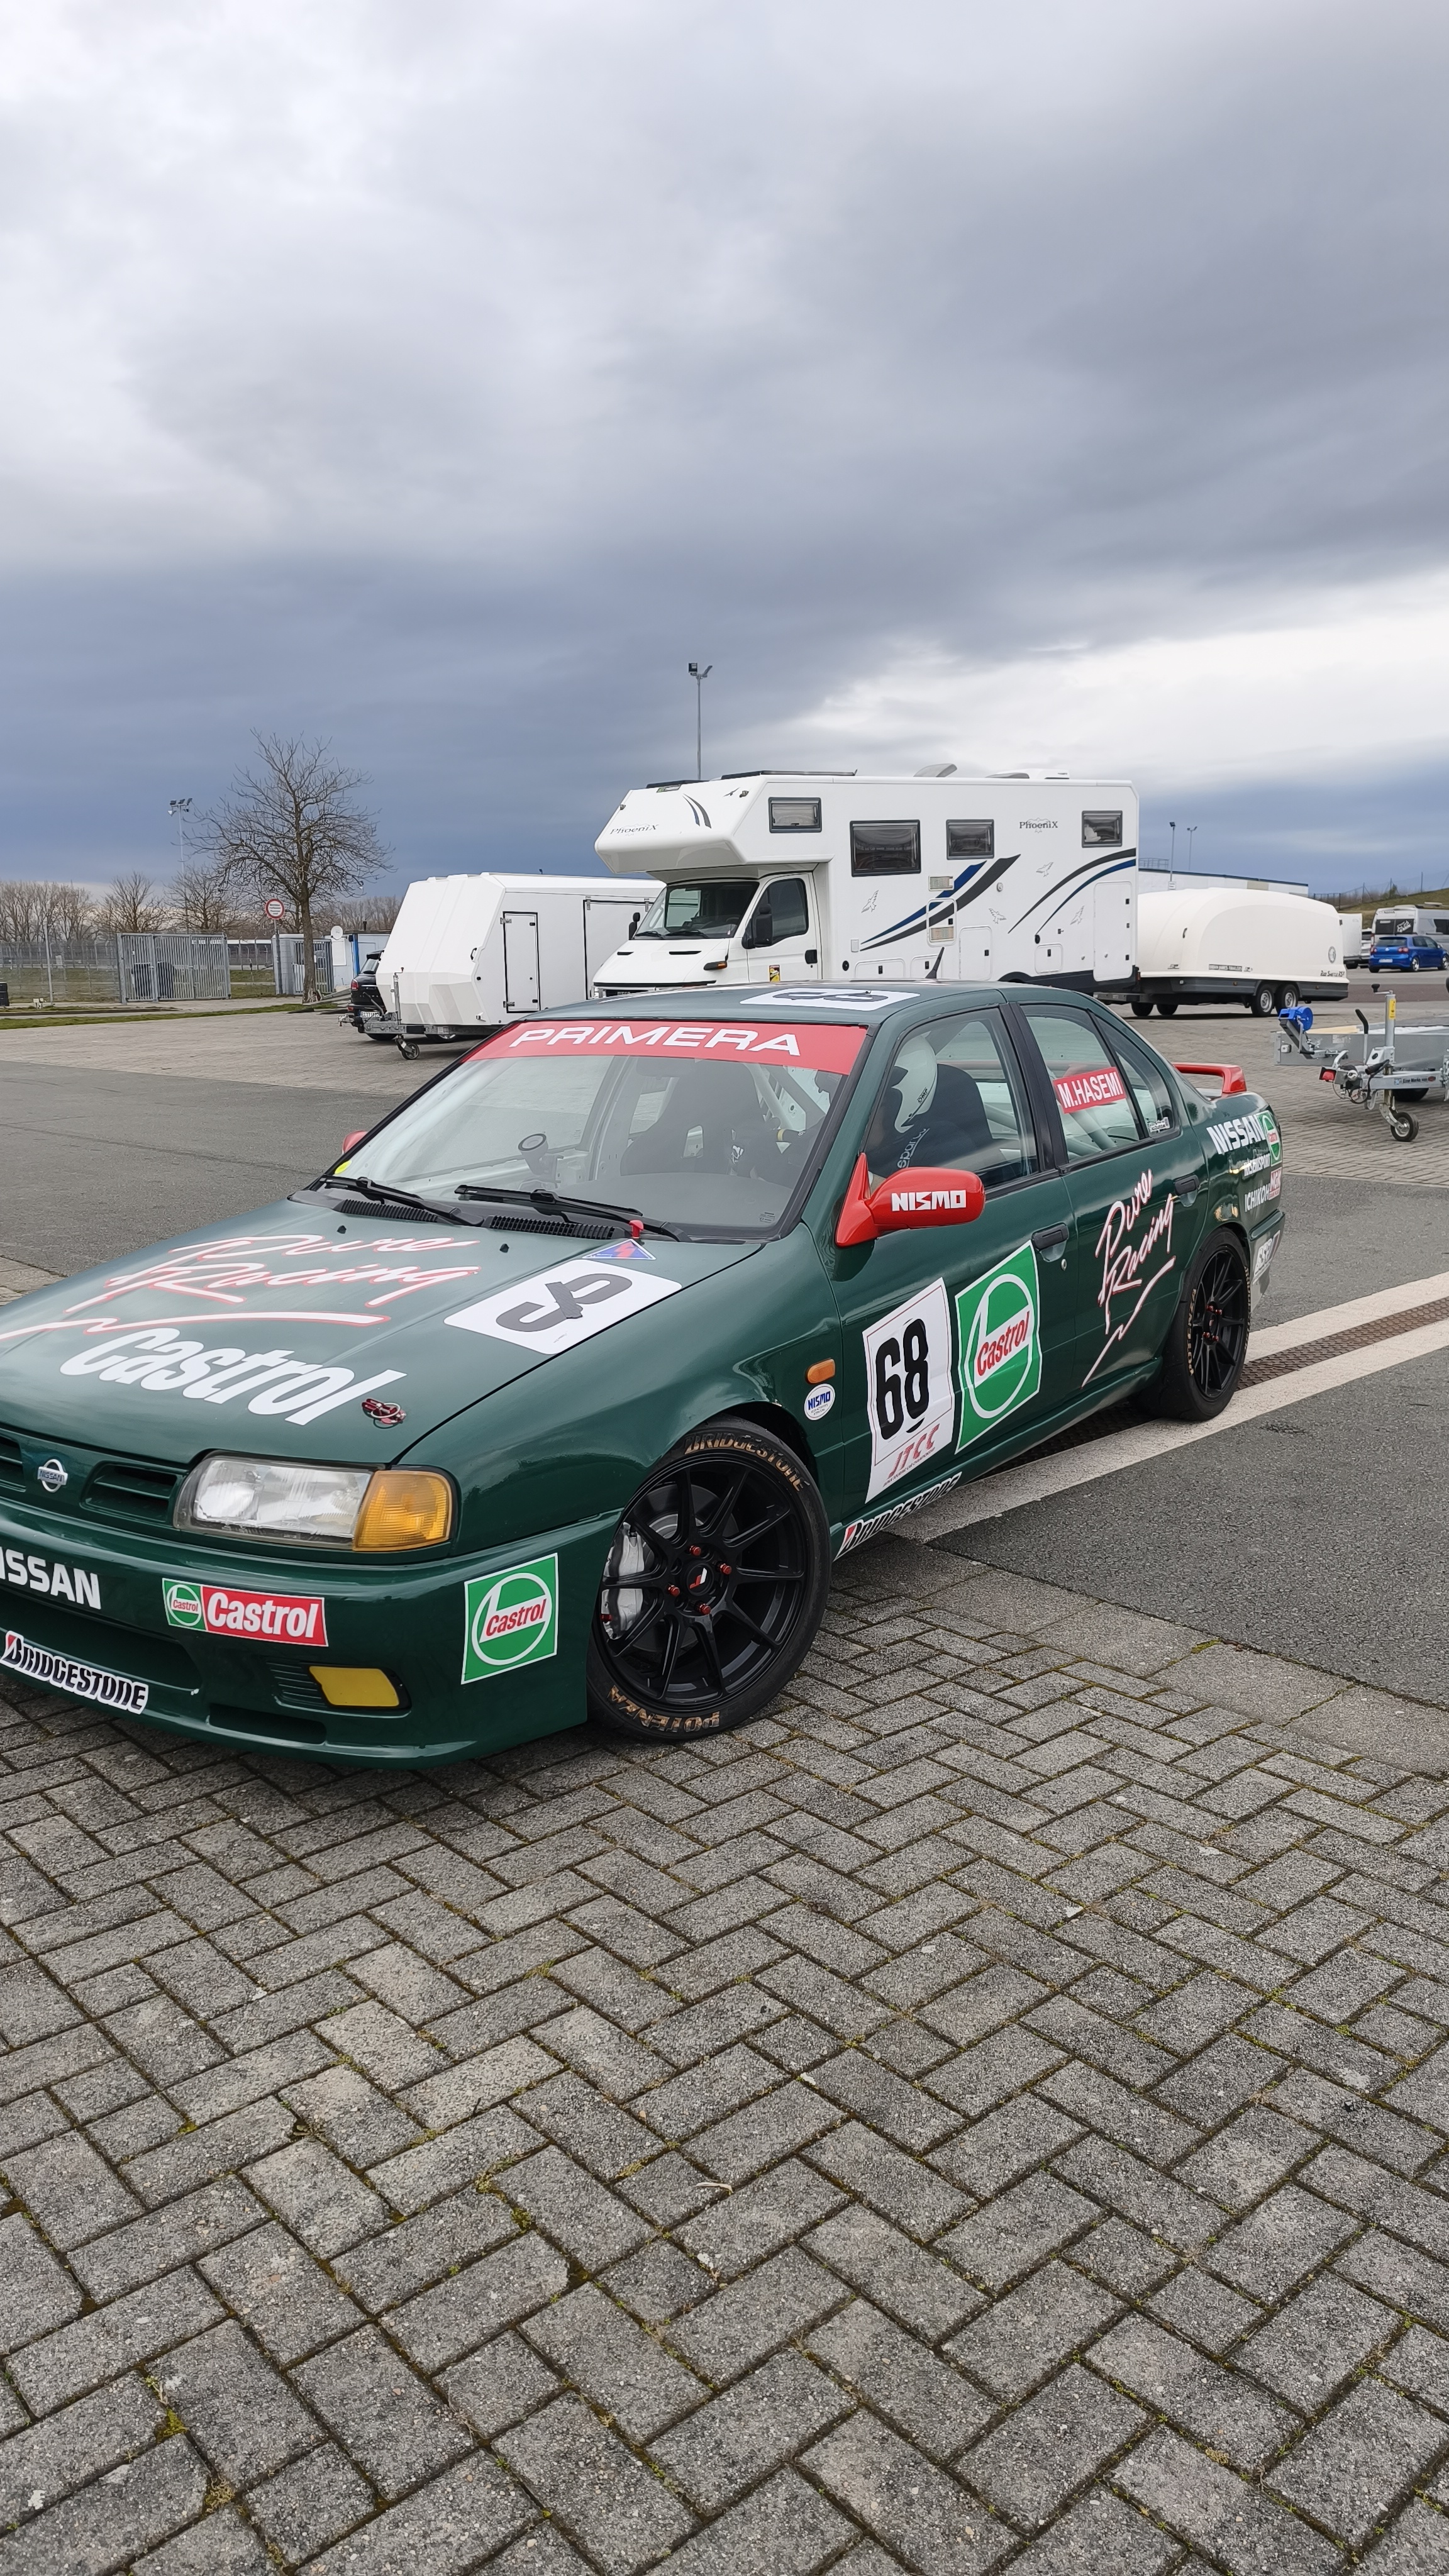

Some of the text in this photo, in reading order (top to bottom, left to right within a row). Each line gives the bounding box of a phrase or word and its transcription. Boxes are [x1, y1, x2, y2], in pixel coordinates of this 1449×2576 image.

[509, 1026, 801, 1057] PRIMERA
[1057, 1071, 1124, 1109] M.HASEMI
[1206, 1114, 1266, 1155] NISSAN
[891, 1189, 967, 1212] NISMO
[1269, 1169, 1282, 1192] NGK
[104, 1233, 481, 1289] Pure
[1095, 1169, 1153, 1307] Pure
[64, 1262, 482, 1313] Racing
[1105, 1193, 1174, 1335] Racing
[977, 1311, 1031, 1377] Castrol
[60, 1328, 408, 1426] Castrol
[808, 1391, 831, 1411] NISMO
[875, 1318, 930, 1440] 68
[39, 1469, 63, 1483] NISSAN
[684, 1431, 811, 1493] BRIDGESTONE
[835, 1474, 961, 1560] BRIDGESTONE
[172, 1591, 319, 1639] Castrol Castrol
[485, 1598, 547, 1638] Castrol
[3, 1633, 148, 1711] BRIDGESTONE
[608, 1685, 721, 1733] POTENZA
